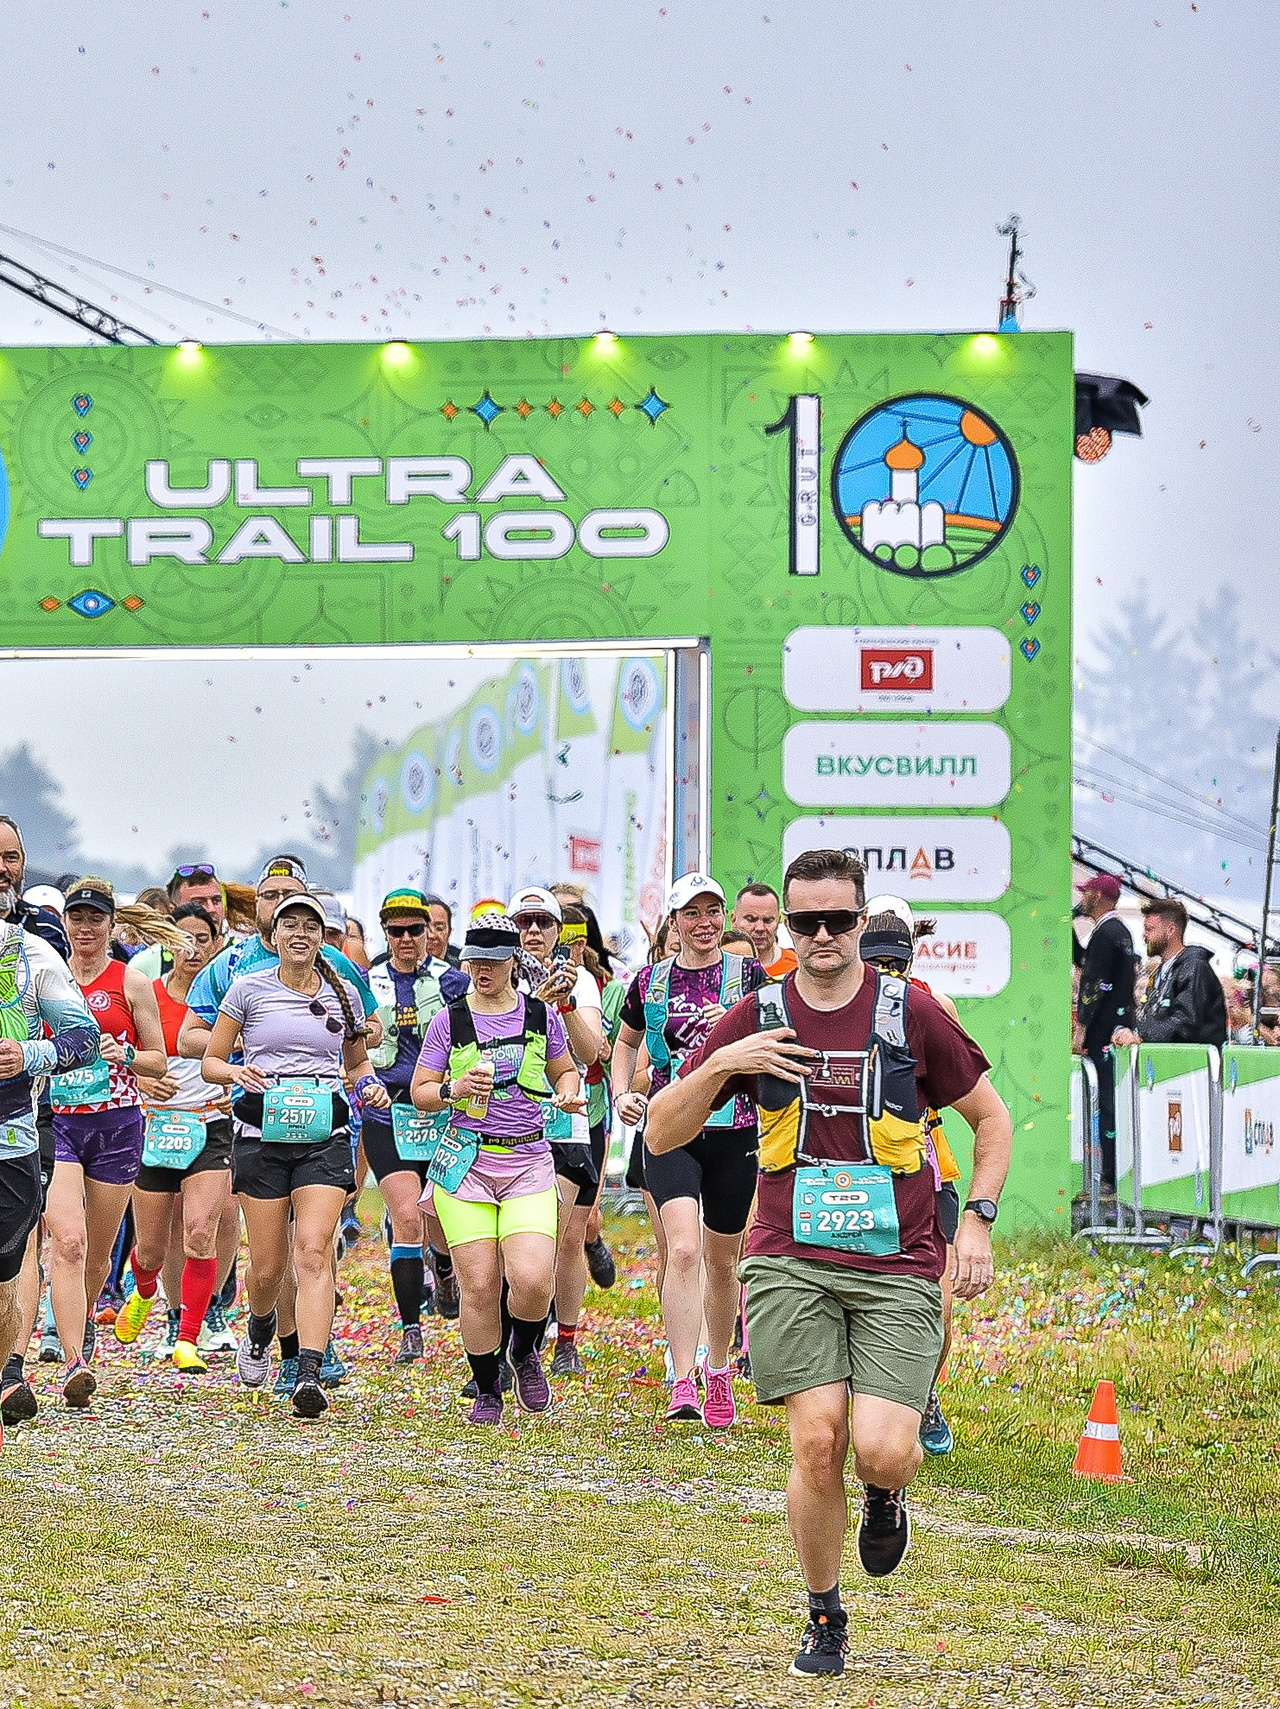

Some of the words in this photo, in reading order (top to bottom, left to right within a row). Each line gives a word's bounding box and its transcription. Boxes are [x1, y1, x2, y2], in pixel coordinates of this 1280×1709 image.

[145, 453, 568, 509] ULTRA
[37, 514, 415, 565] TRAIL
[442, 507, 670, 561] 100
[817, 756, 978, 776] ВКУСВИЛЛ
[58, 1069, 95, 1086] 2975
[279, 1108, 316, 1125] 2517
[157, 1135, 193, 1151] 2203
[816, 1209, 876, 1232] 2923
